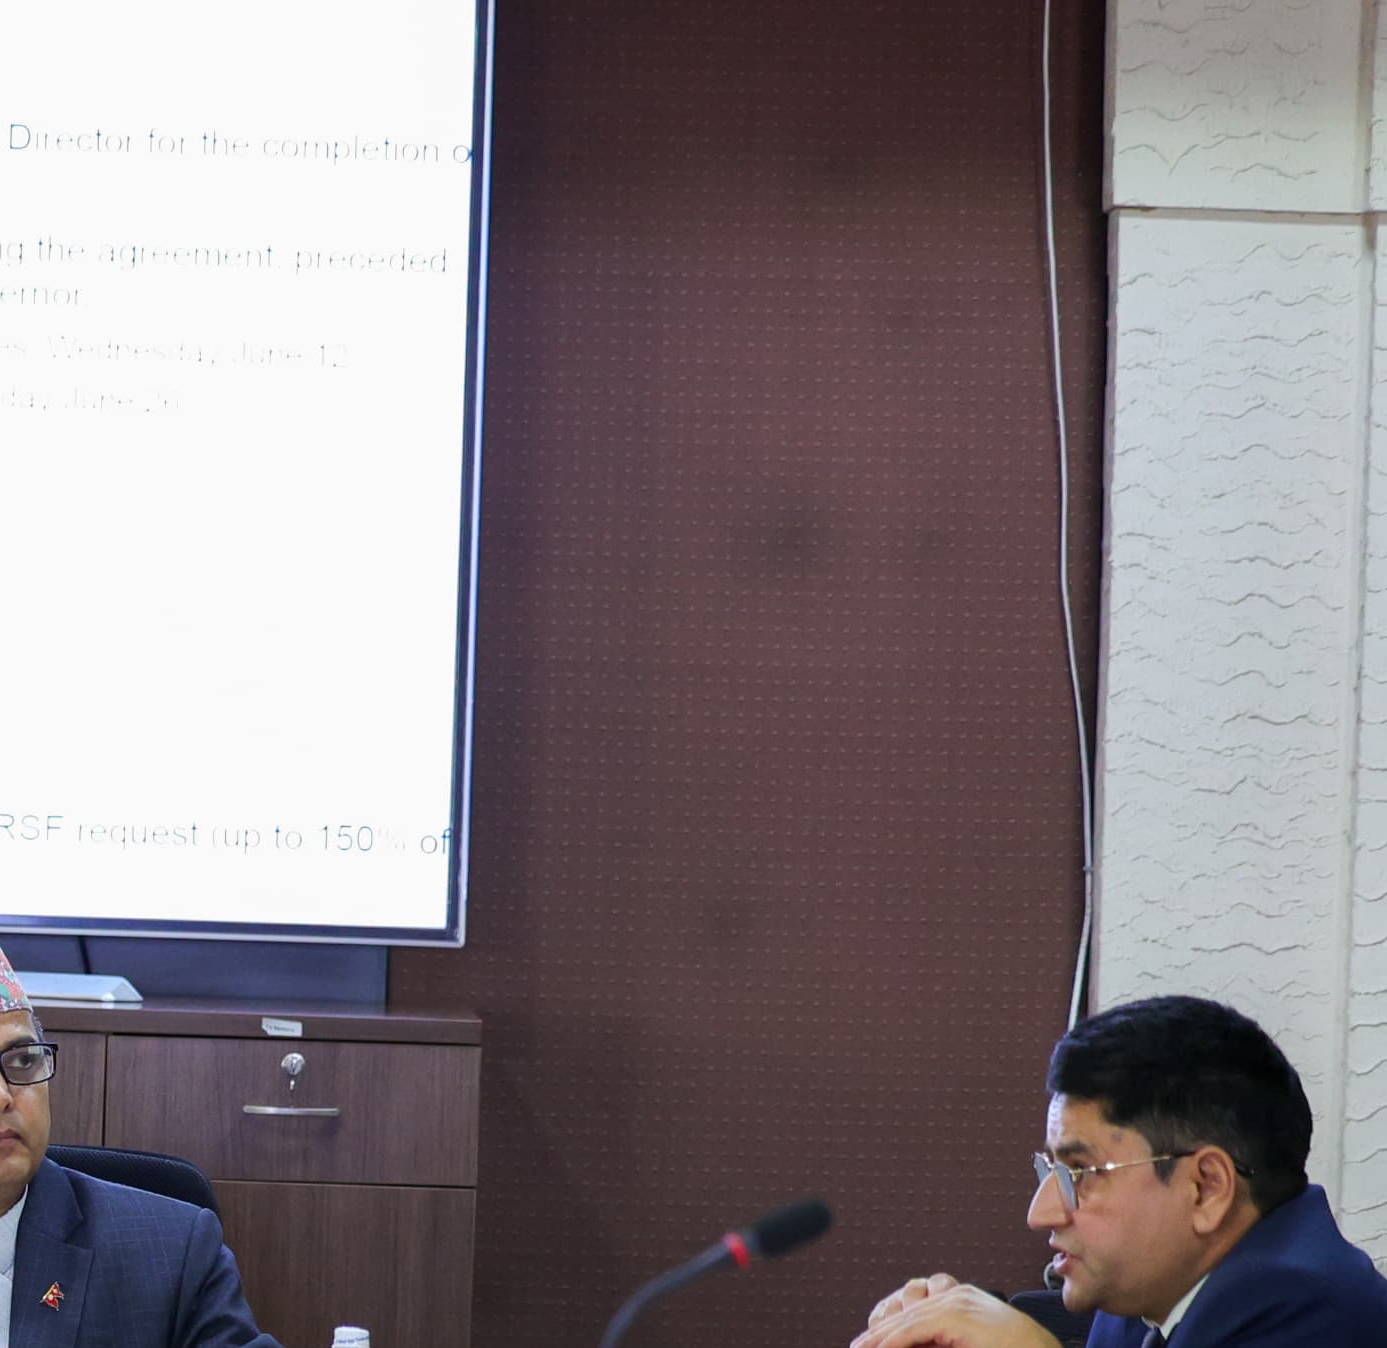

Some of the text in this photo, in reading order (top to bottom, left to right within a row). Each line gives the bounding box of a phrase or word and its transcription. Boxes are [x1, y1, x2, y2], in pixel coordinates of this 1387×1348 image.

[9, 122, 131, 153] Director
[147, 128, 185, 155] for
[201, 128, 249, 156] the
[263, 134, 439, 166] completion
[37, 235, 85, 262] the
[295, 247, 448, 276] preceded
[78, 820, 200, 852] request
[271, 823, 305, 850] to
